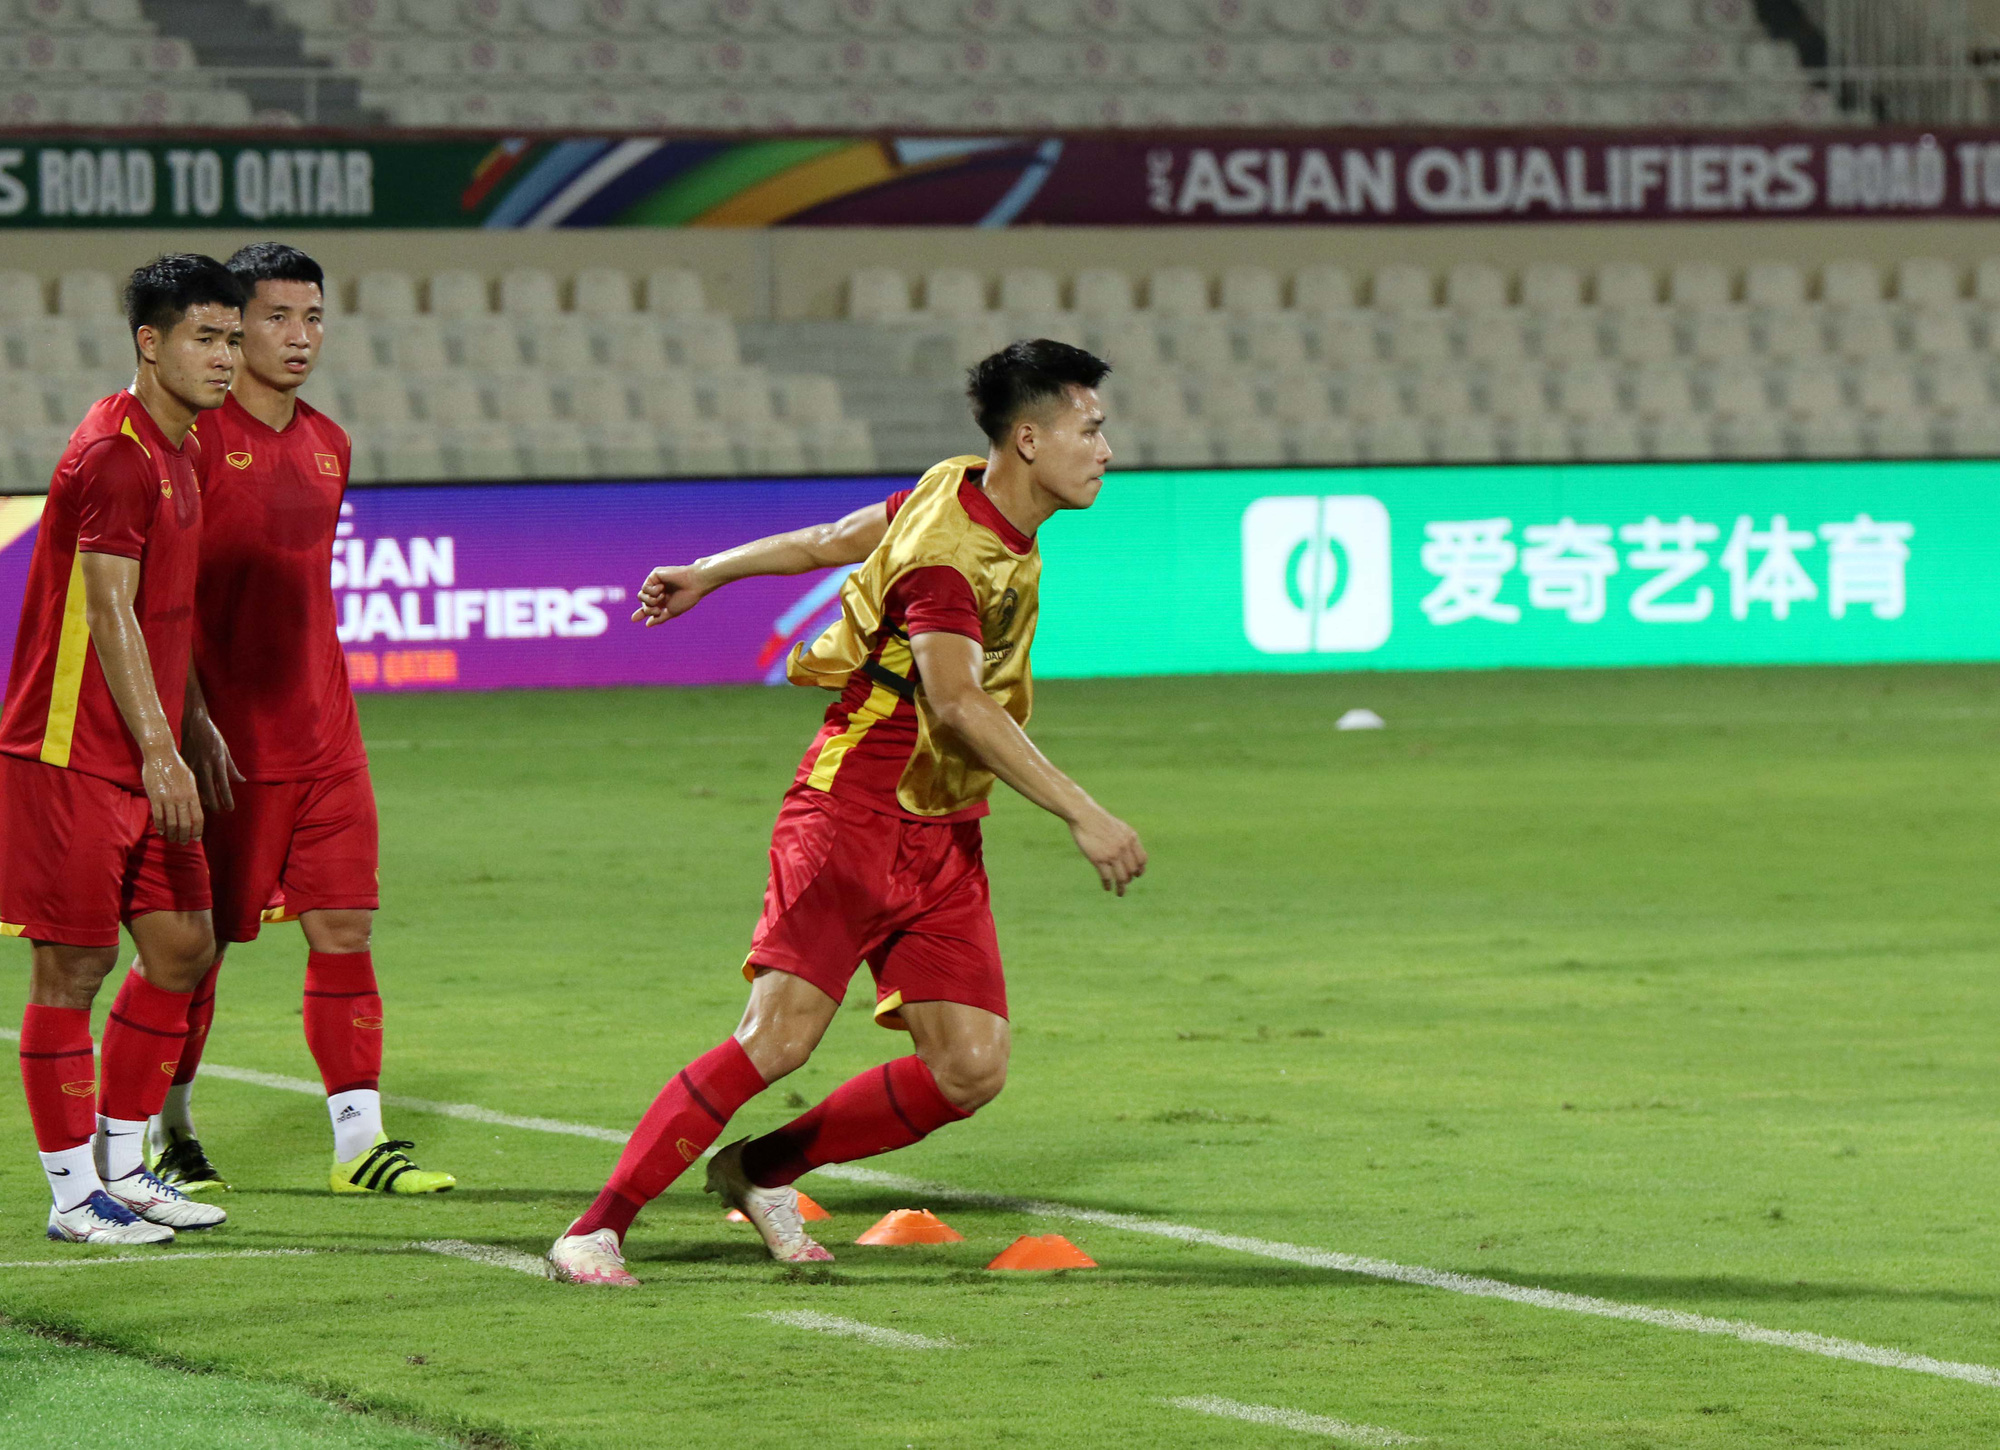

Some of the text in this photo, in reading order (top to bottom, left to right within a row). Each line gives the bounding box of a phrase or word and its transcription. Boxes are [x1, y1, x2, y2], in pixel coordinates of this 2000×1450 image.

[39, 150, 155, 215] ROAD
[166, 150, 223, 215] TO
[235, 150, 373, 218] QATAR
[1178, 147, 1395, 214] ASIAN
[1406, 145, 1816, 213] QUALIFIERS
[1826, 143, 1946, 208] ROAD
[1420, 513, 1914, 624] 爱奇艺体育
